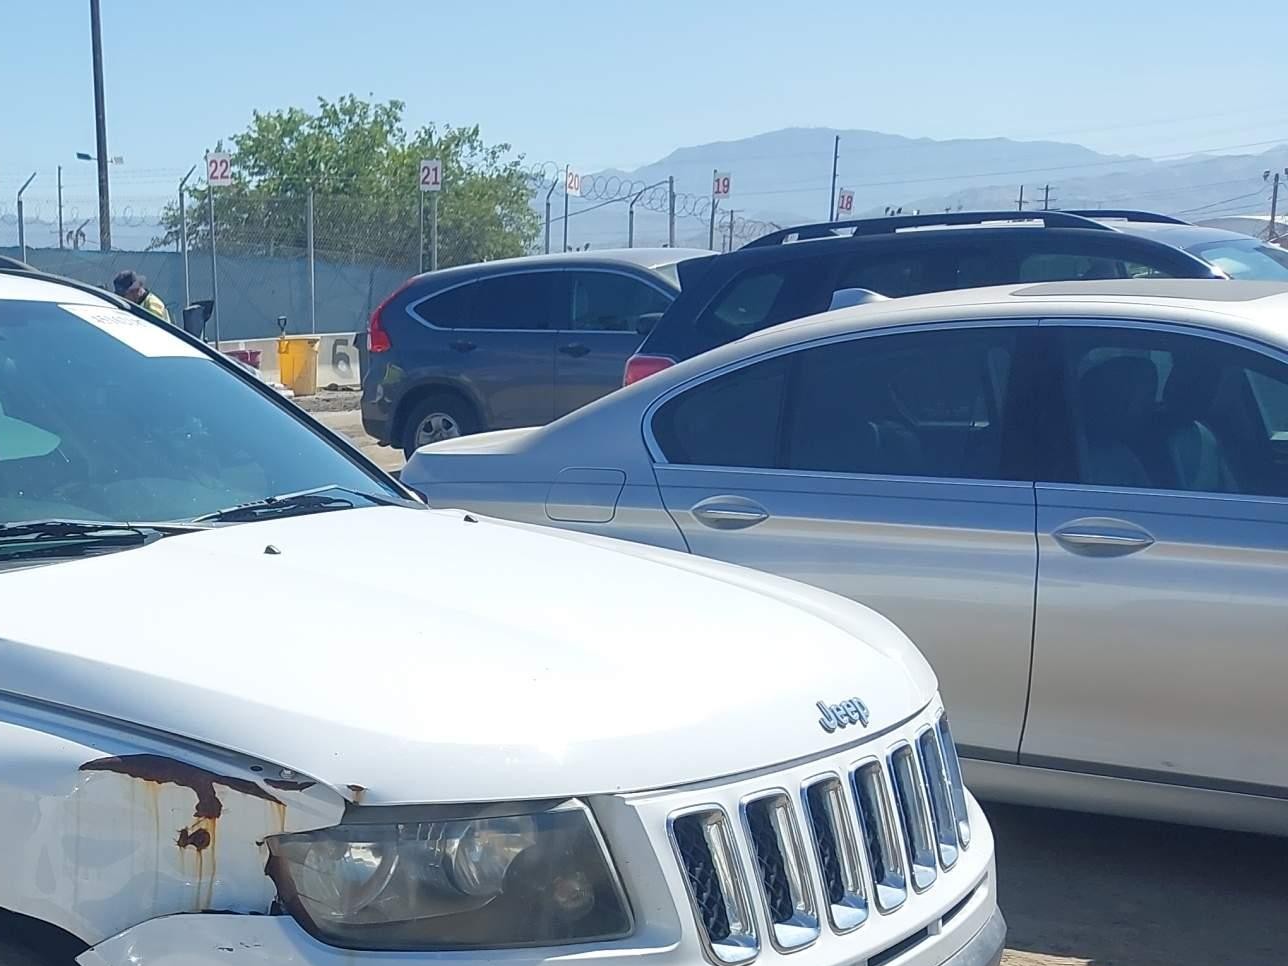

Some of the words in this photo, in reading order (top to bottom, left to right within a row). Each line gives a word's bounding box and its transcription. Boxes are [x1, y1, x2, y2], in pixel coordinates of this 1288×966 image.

[209, 159, 229, 180] 22
[421, 166, 440, 186] 21
[567, 172, 580, 191] 20
[714, 177, 730, 194] 19
[839, 195, 853, 210] 18
[816, 697, 870, 733] Jeep
